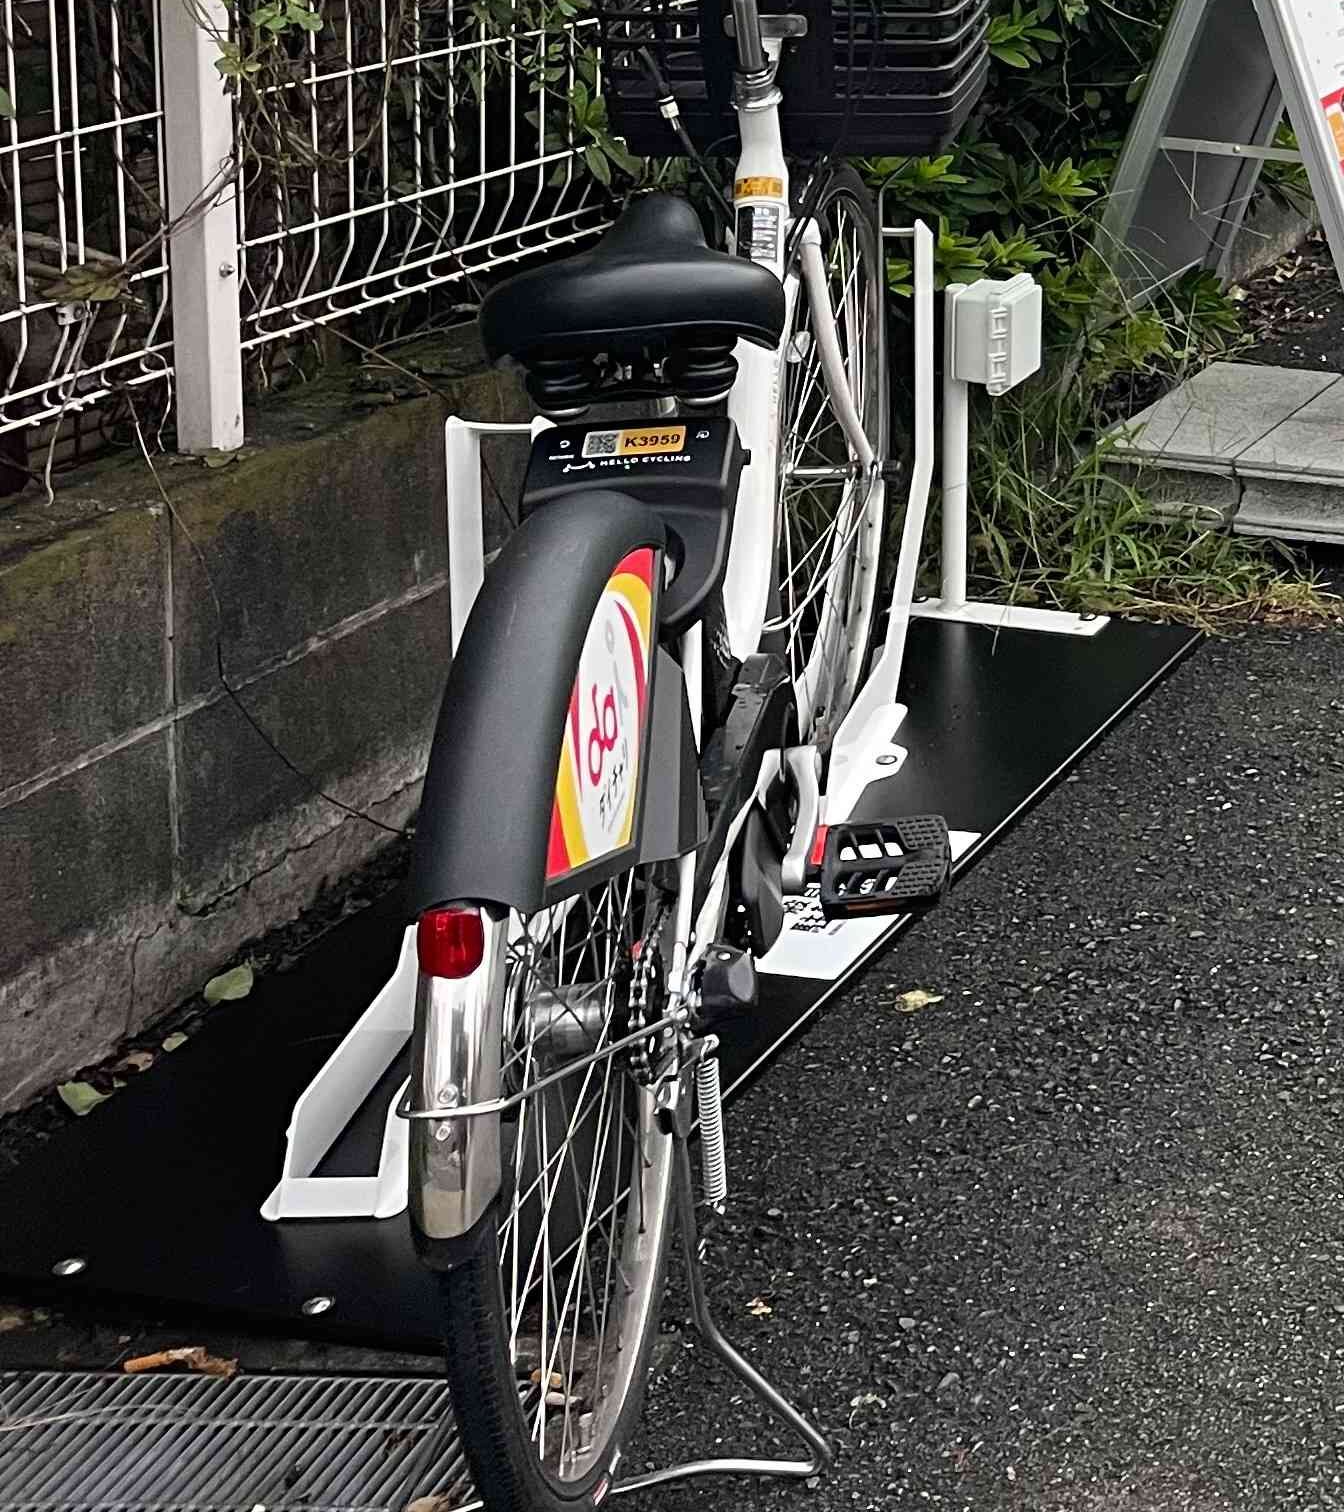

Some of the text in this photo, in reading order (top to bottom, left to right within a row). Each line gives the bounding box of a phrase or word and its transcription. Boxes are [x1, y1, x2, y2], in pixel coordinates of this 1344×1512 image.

[624, 433, 681, 449] K3959
[600, 455, 691, 466] HELLO CYCLING
